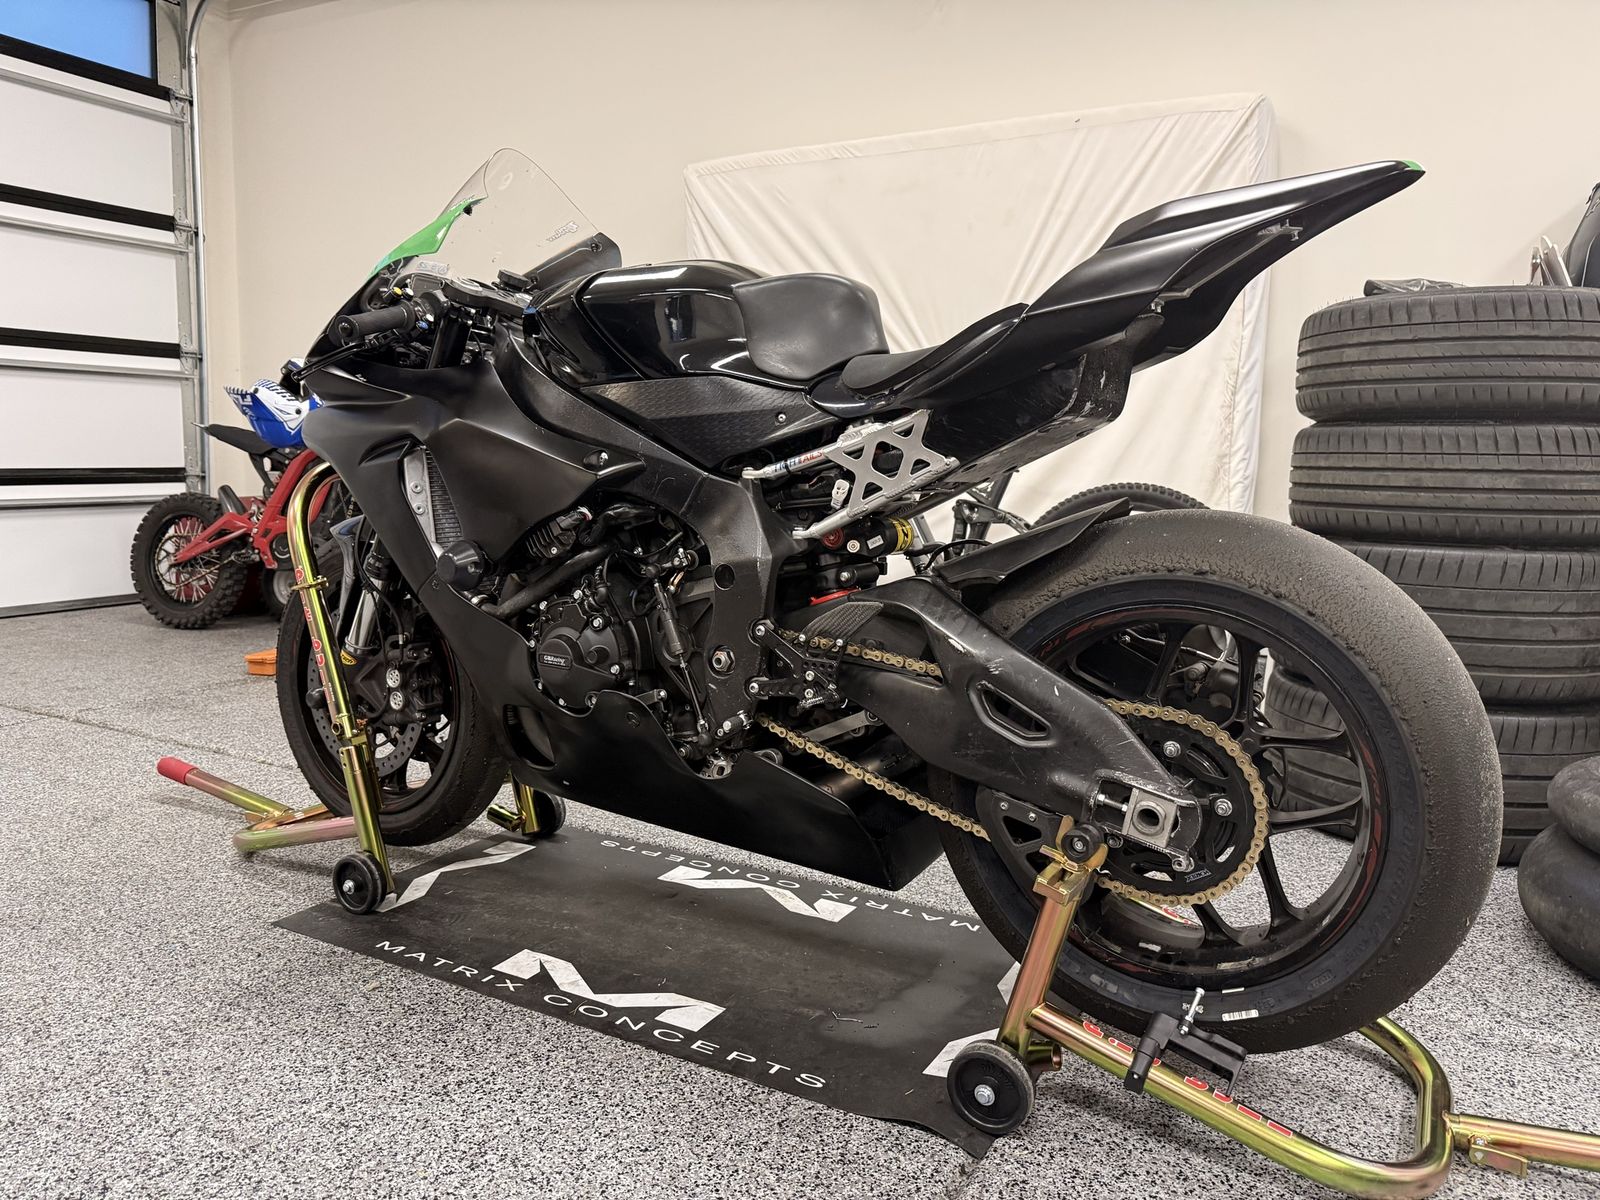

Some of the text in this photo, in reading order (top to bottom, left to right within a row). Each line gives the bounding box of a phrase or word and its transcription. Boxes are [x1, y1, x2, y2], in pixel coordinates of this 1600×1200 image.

[600, 840, 980, 932] MATRIX CONCEPTS
[375, 941, 826, 1088] MATRIX CONCEPTS
